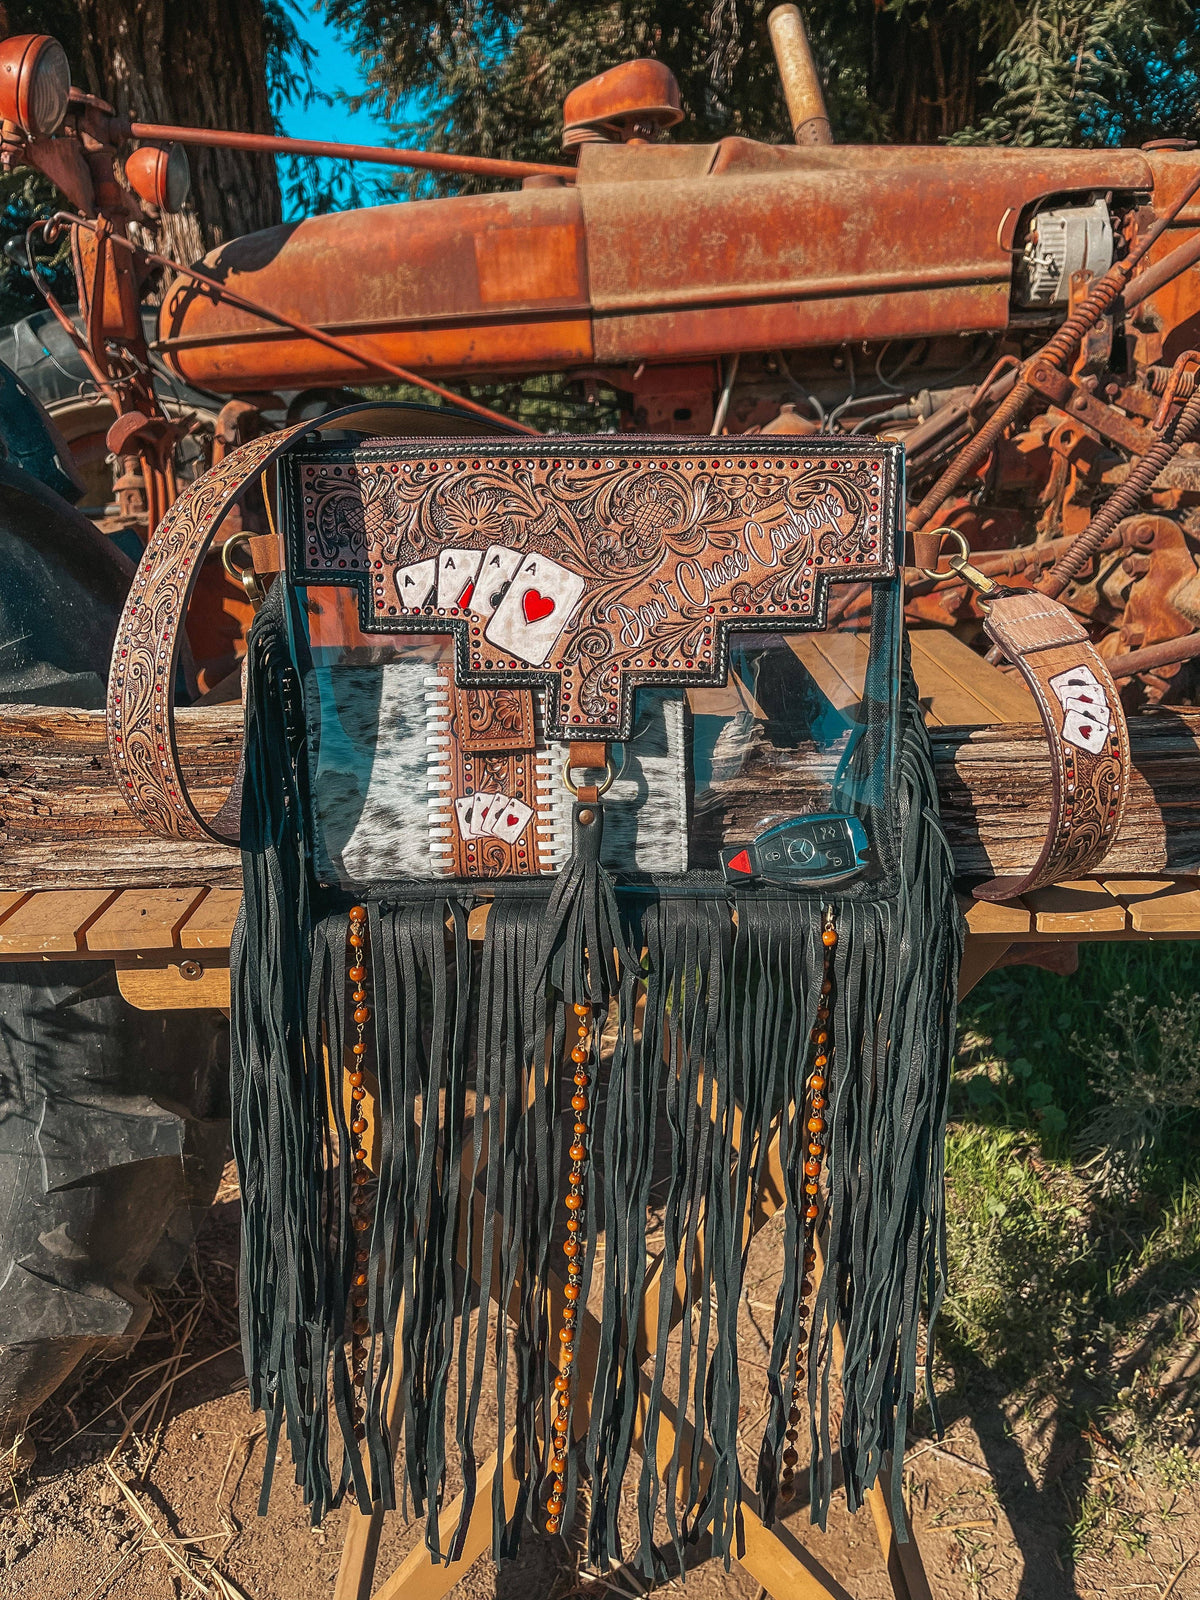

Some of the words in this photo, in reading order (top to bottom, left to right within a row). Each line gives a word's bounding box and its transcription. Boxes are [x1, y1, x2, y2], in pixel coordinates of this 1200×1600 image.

[444, 556, 456, 570] A
[489, 554, 501, 568] A
[525, 562, 537, 576] A
[604, 579, 679, 649] Don't
[675, 550, 749, 608] Chase
[743, 495, 844, 567] Cowboys
[404, 574, 416, 588] A
